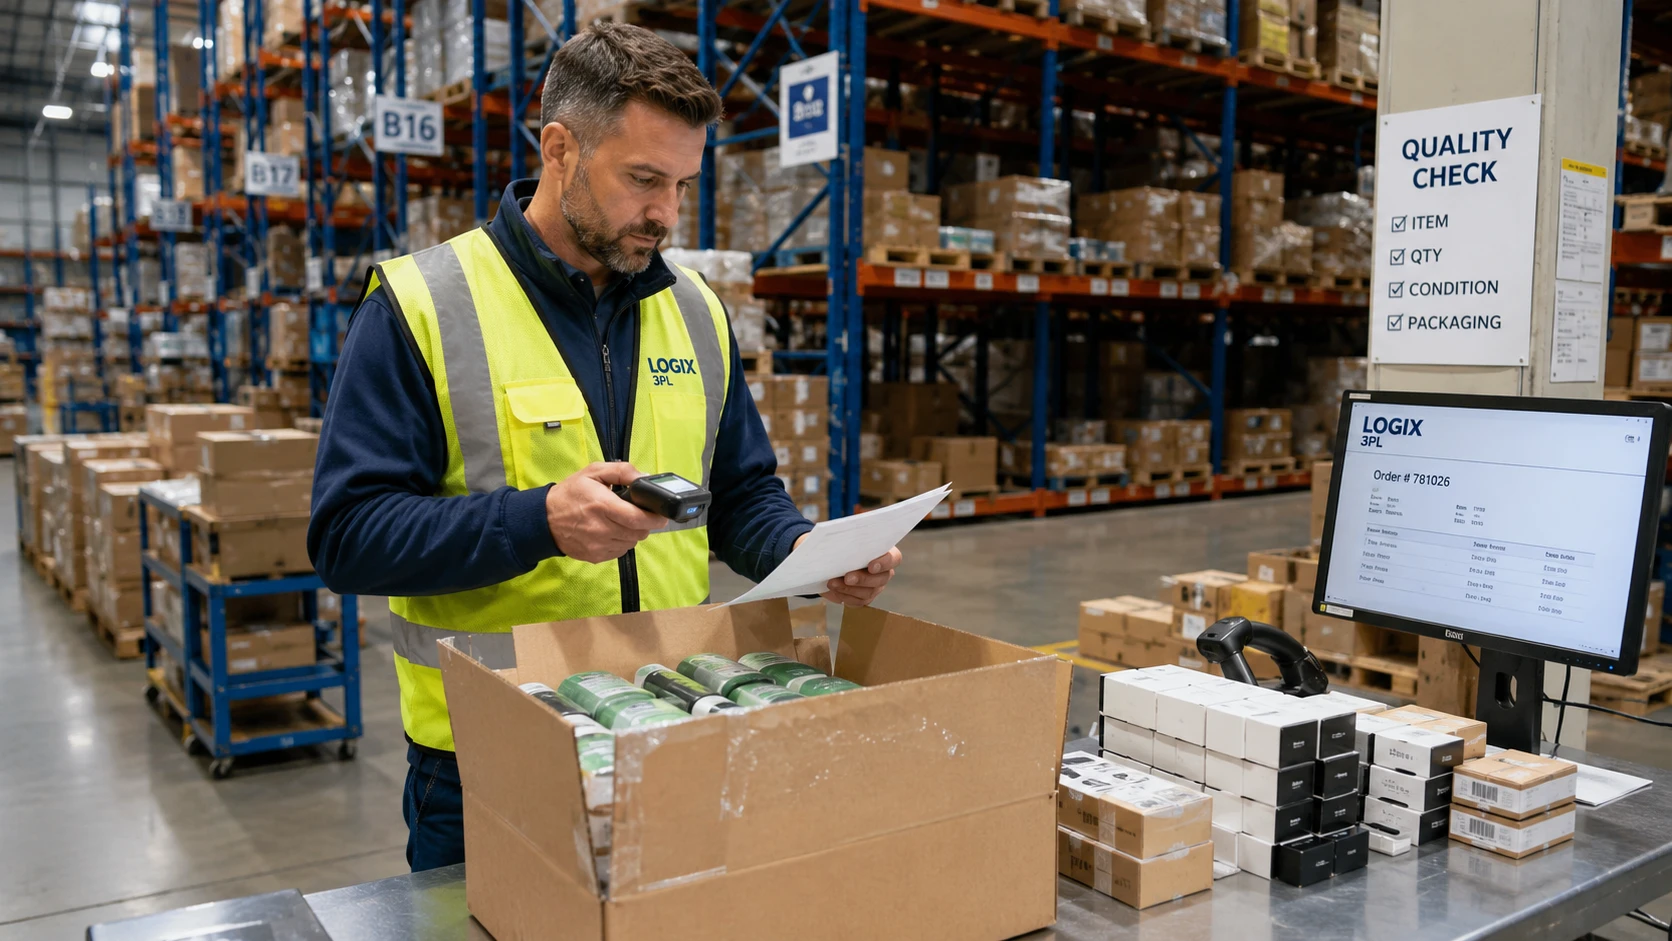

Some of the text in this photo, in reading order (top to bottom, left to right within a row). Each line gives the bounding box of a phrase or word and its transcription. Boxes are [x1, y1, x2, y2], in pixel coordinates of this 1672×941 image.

[383, 111, 436, 141] B16
[1401, 127, 1513, 161] QUALITY
[252, 163, 294, 184] B17
[1412, 160, 1498, 189] CHECK
[1411, 214, 1449, 230] ITEM
[1410, 248, 1442, 265] QTY
[1409, 280, 1499, 296] CONDITION
[1408, 315, 1502, 330] PACKAGING
[647, 357, 697, 375] LOGIX
[652, 375, 674, 386] 3PL
[1362, 415, 1424, 436] LOGIX
[1360, 435, 1383, 448] 3PL
[1373, 469, 1451, 487] Order # 781026
